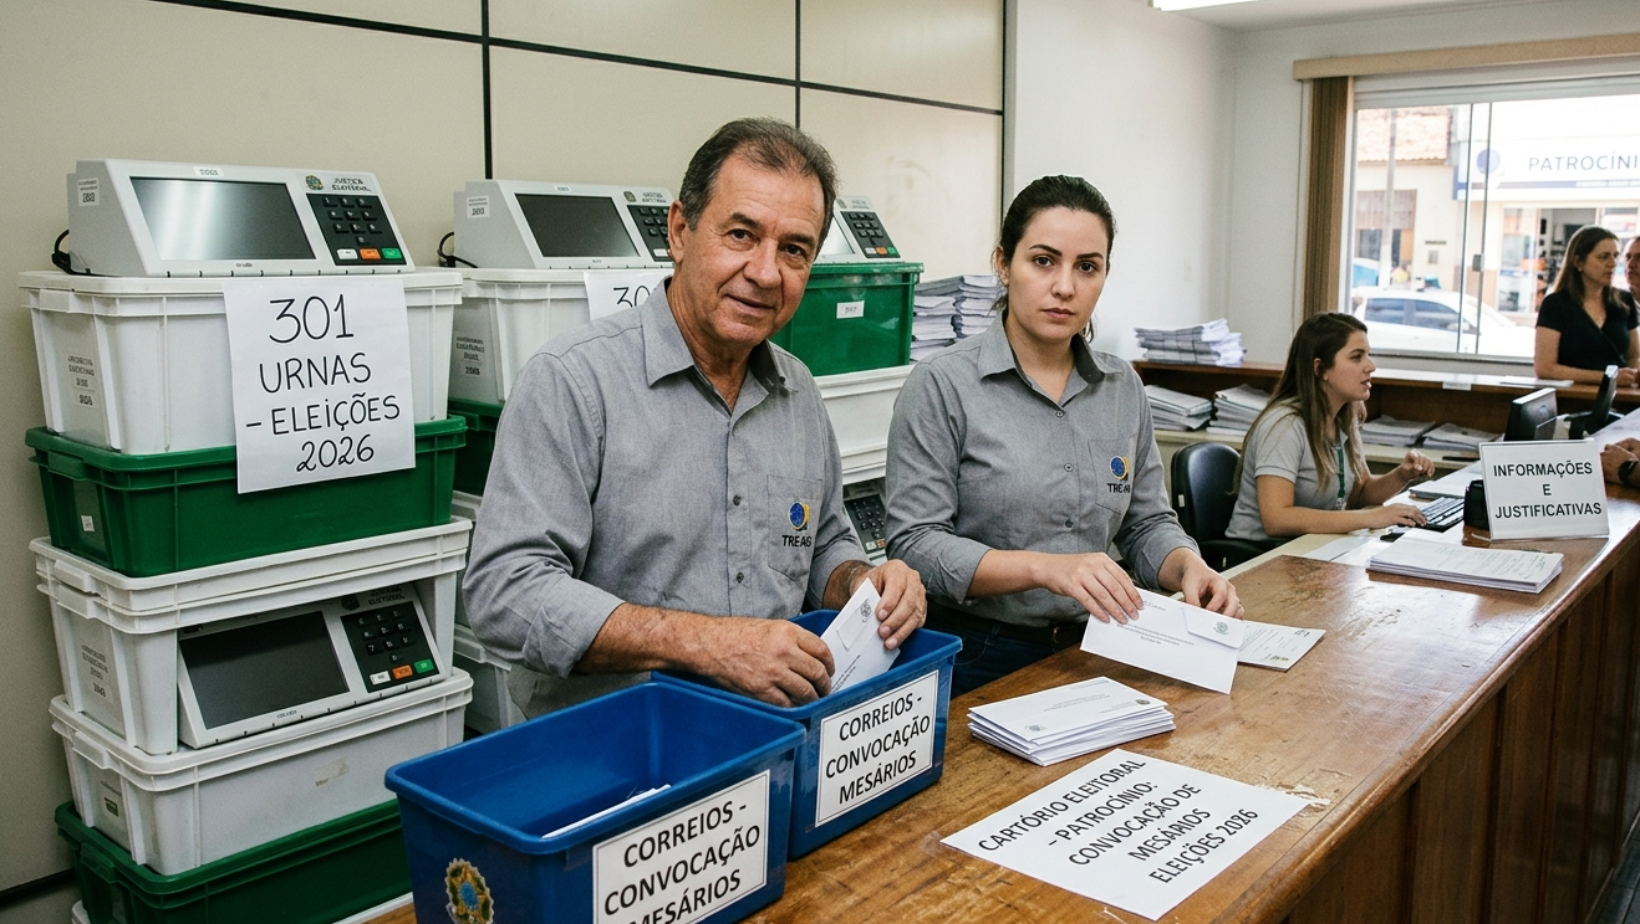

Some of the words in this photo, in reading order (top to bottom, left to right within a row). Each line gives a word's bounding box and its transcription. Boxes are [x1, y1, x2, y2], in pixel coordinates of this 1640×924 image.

[269, 293, 355, 344] 301
[259, 352, 371, 393] URNAS
[271, 393, 400, 436] ELEIÇÕES
[296, 433, 375, 473] 2026
[1493, 460, 1593, 479] INFORMAÇÕES
[1495, 502, 1602, 519] JUSTIFICATIVAS
[1542, 483, 1552, 496] E
[839, 692, 914, 741] CORREIOS
[825, 713, 930, 779] CONVOCAÇÃO
[839, 750, 917, 804] MESÁRIOS
[1172, 784, 1202, 799] DE
[978, 801, 1069, 851] CARTÓRIO
[1062, 760, 1146, 804] ELEITORAL
[1054, 781, 1158, 841] PATROCÍNIO:
[1215, 808, 1258, 836] 2026
[623, 800, 733, 868] CORREIOS
[603, 824, 760, 916] CONVOCAÇÃO
